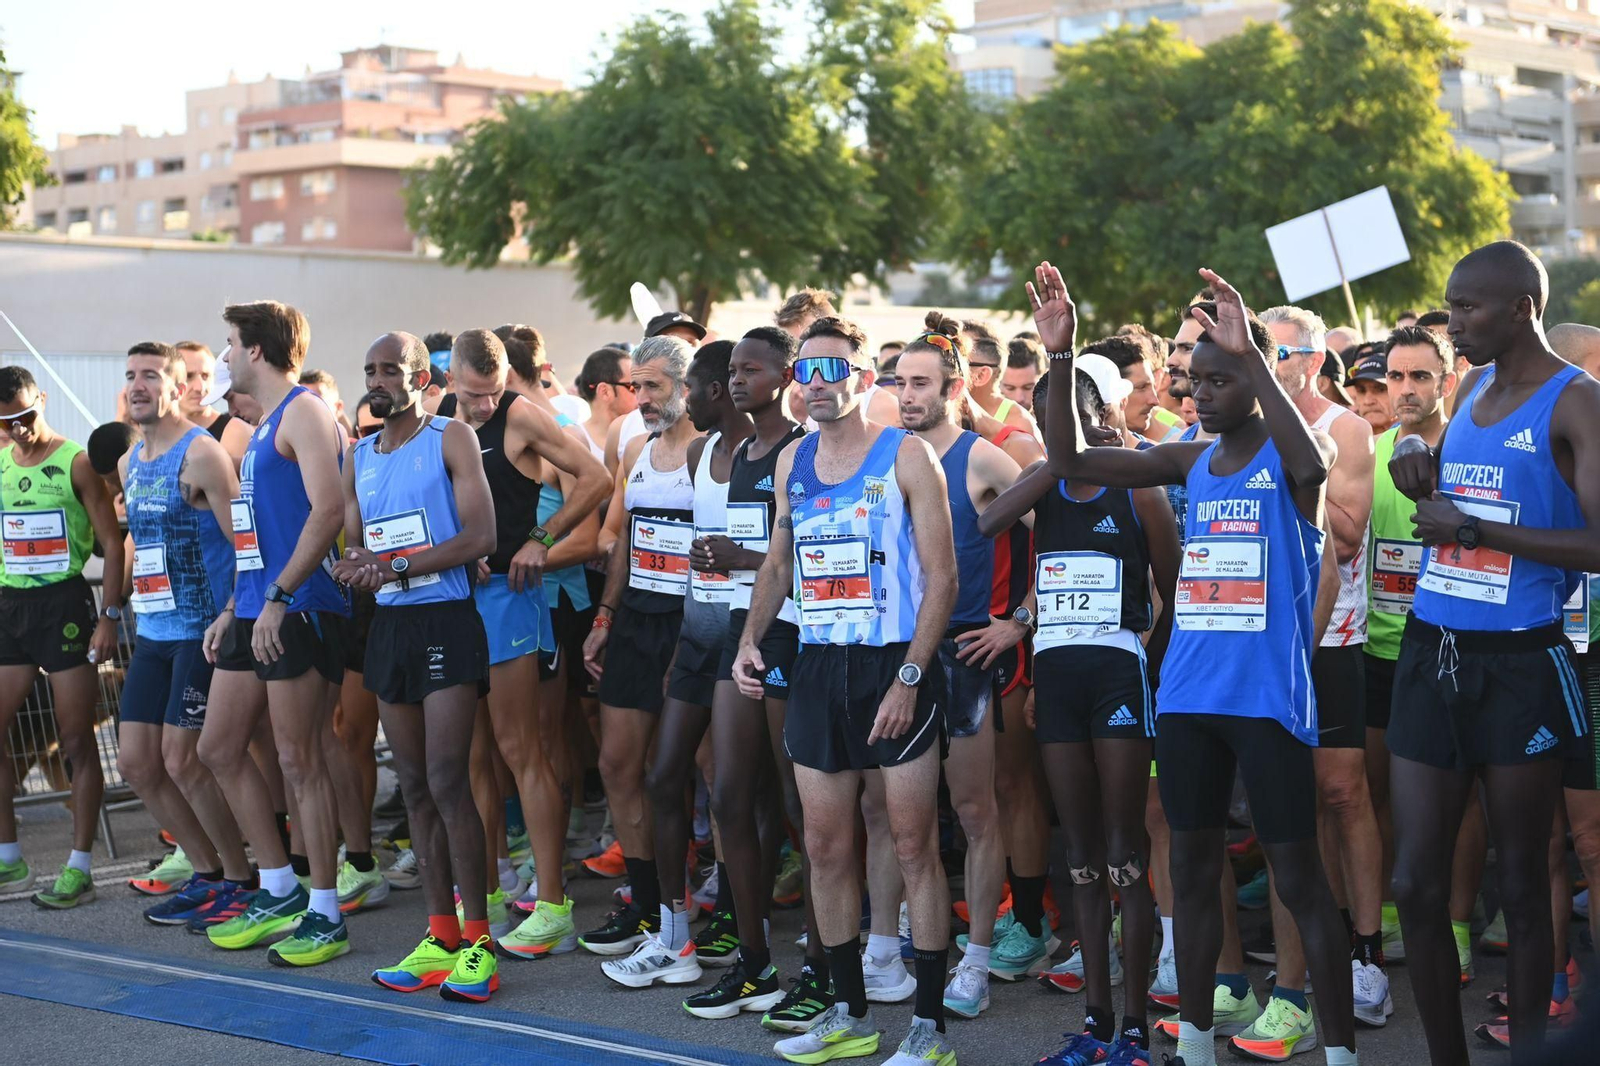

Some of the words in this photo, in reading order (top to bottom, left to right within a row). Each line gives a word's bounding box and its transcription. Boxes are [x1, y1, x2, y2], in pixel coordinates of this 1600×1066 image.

[1504, 440, 1536, 453] adidas
[754, 484, 775, 492] adidas
[1245, 481, 1276, 489] adidas
[1093, 526, 1119, 534] adidas
[1221, 521, 1256, 532] RACING
[28, 541, 35, 554] 8
[649, 554, 666, 570] 33
[1484, 564, 1507, 573] málaga
[1447, 568, 1466, 577] MUTAI
[1467, 572, 1492, 581] MUTAI
[826, 580, 846, 596] 70
[1398, 577, 1417, 591] 55
[1209, 582, 1220, 600] 2
[1056, 593, 1090, 611] F12
[1107, 718, 1138, 726] adidas
[1525, 736, 1558, 755] adidas
